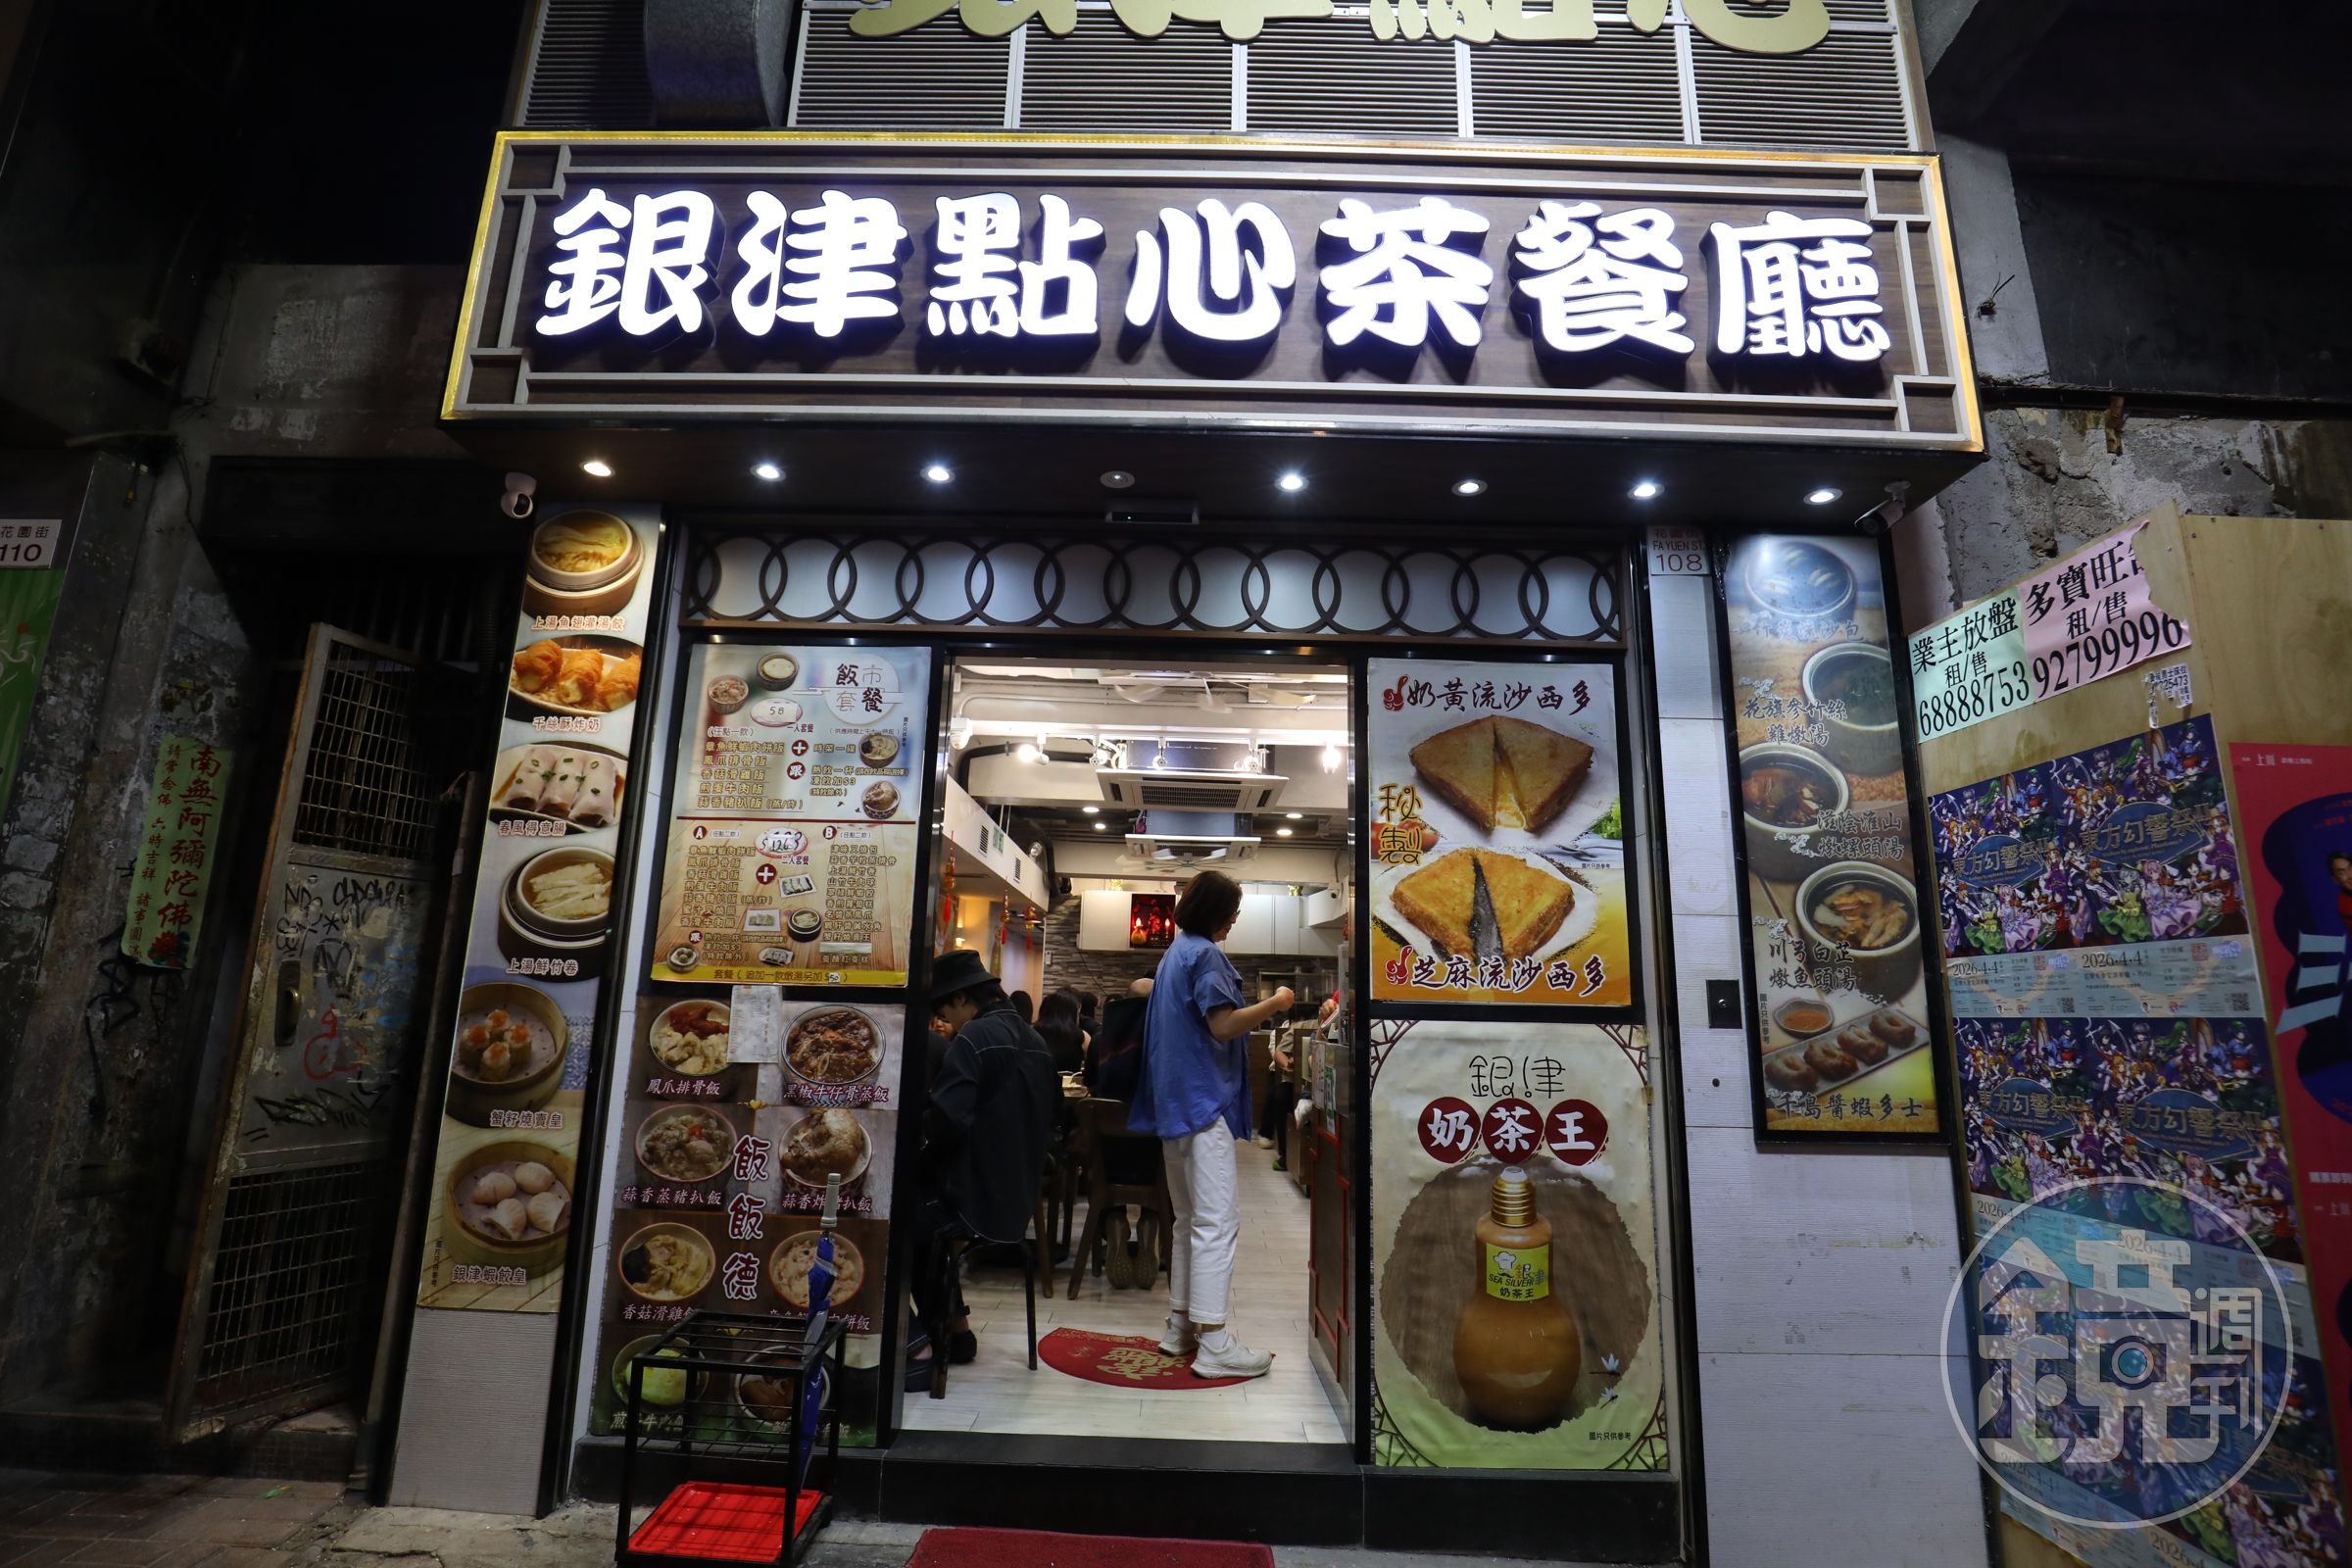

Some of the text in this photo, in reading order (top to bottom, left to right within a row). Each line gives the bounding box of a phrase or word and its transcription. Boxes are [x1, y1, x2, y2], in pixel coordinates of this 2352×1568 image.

[535, 188, 1891, 362] 銀津點心茶餐廳
[0, 525, 50, 538] 花園街
[0, 544, 42, 562] 110
[1653, 541, 1664, 550] FA
[1666, 541, 1690, 551] YUEN
[1656, 554, 1702, 571] 108
[2066, 592, 2128, 640] 租/售
[1912, 597, 2019, 675] 業主放盤
[2033, 611, 2183, 699] 92799996
[1944, 651, 1987, 688] 租/售
[1406, 677, 1592, 715] 奶黃流沙西多
[1919, 661, 2031, 736] 68888753
[1742, 697, 1848, 722] 花旗參竹絲
[1766, 722, 1830, 746] 雞燉湯
[499, 820, 566, 837] 春風得意腸
[695, 827, 704, 839] A
[825, 826, 834, 838] B
[1378, 783, 1423, 866] 秘製
[157, 747, 221, 930] 南無阿彌陀佛
[507, 957, 578, 976] 上湯鮮竹卷
[1410, 955, 1607, 996] 芝麻流沙西多
[1769, 966, 1856, 992] 燉魚頭湯
[645, 1078, 722, 1097] 鳳爪排骨飯
[1469, 1054, 1566, 1100] 銀津
[783, 1083, 890, 1103] 黑椒牛仔骨蒸飯
[1775, 1092, 1924, 1121] 千島醬蝦多士
[490, 1109, 564, 1129] 蟹籽燒賣皇
[1427, 1104, 1596, 1152] 奶茶王
[621, 1186, 722, 1205] 蒜香蒸豬扒飯
[723, 1134, 771, 1300] 飯飯德
[454, 1264, 527, 1286] 銀津蝦餃皇
[1489, 1273, 1534, 1287] SEA SILVER
[1499, 1288, 1534, 1298] 奶茶王
